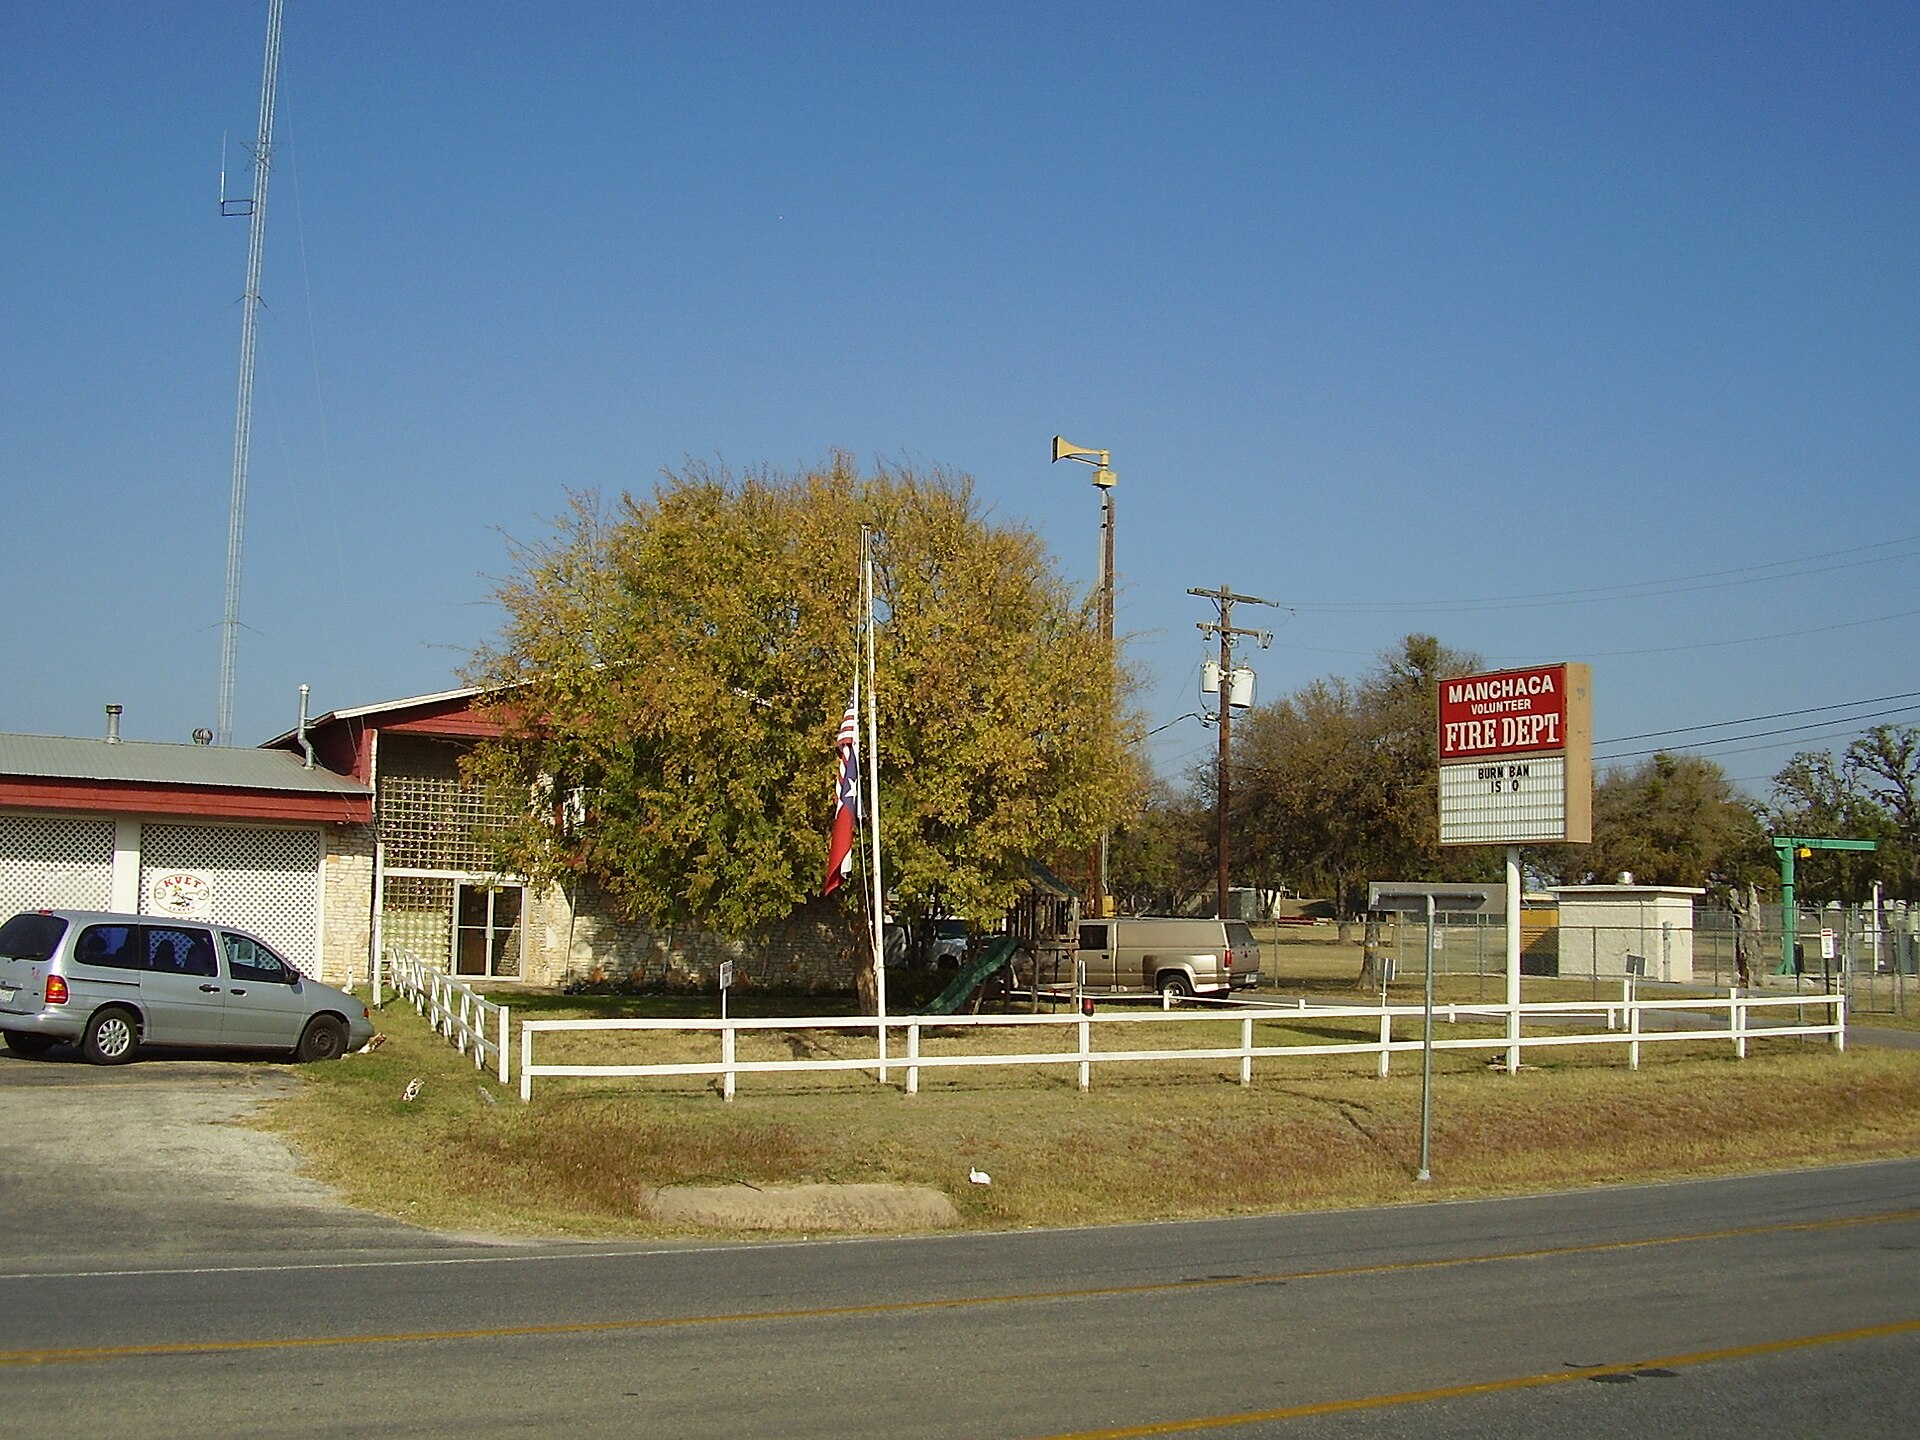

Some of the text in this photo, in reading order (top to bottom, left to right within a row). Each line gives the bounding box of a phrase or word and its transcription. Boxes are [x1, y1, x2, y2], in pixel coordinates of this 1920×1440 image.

[1448, 675, 1555, 703] MANCHACA
[1471, 698, 1532, 715] VOLUNTEER
[1444, 712, 1560, 752] FIRE DEPT
[1478, 764, 1529, 780] BURN BAN
[1491, 780, 1502, 793] IS
